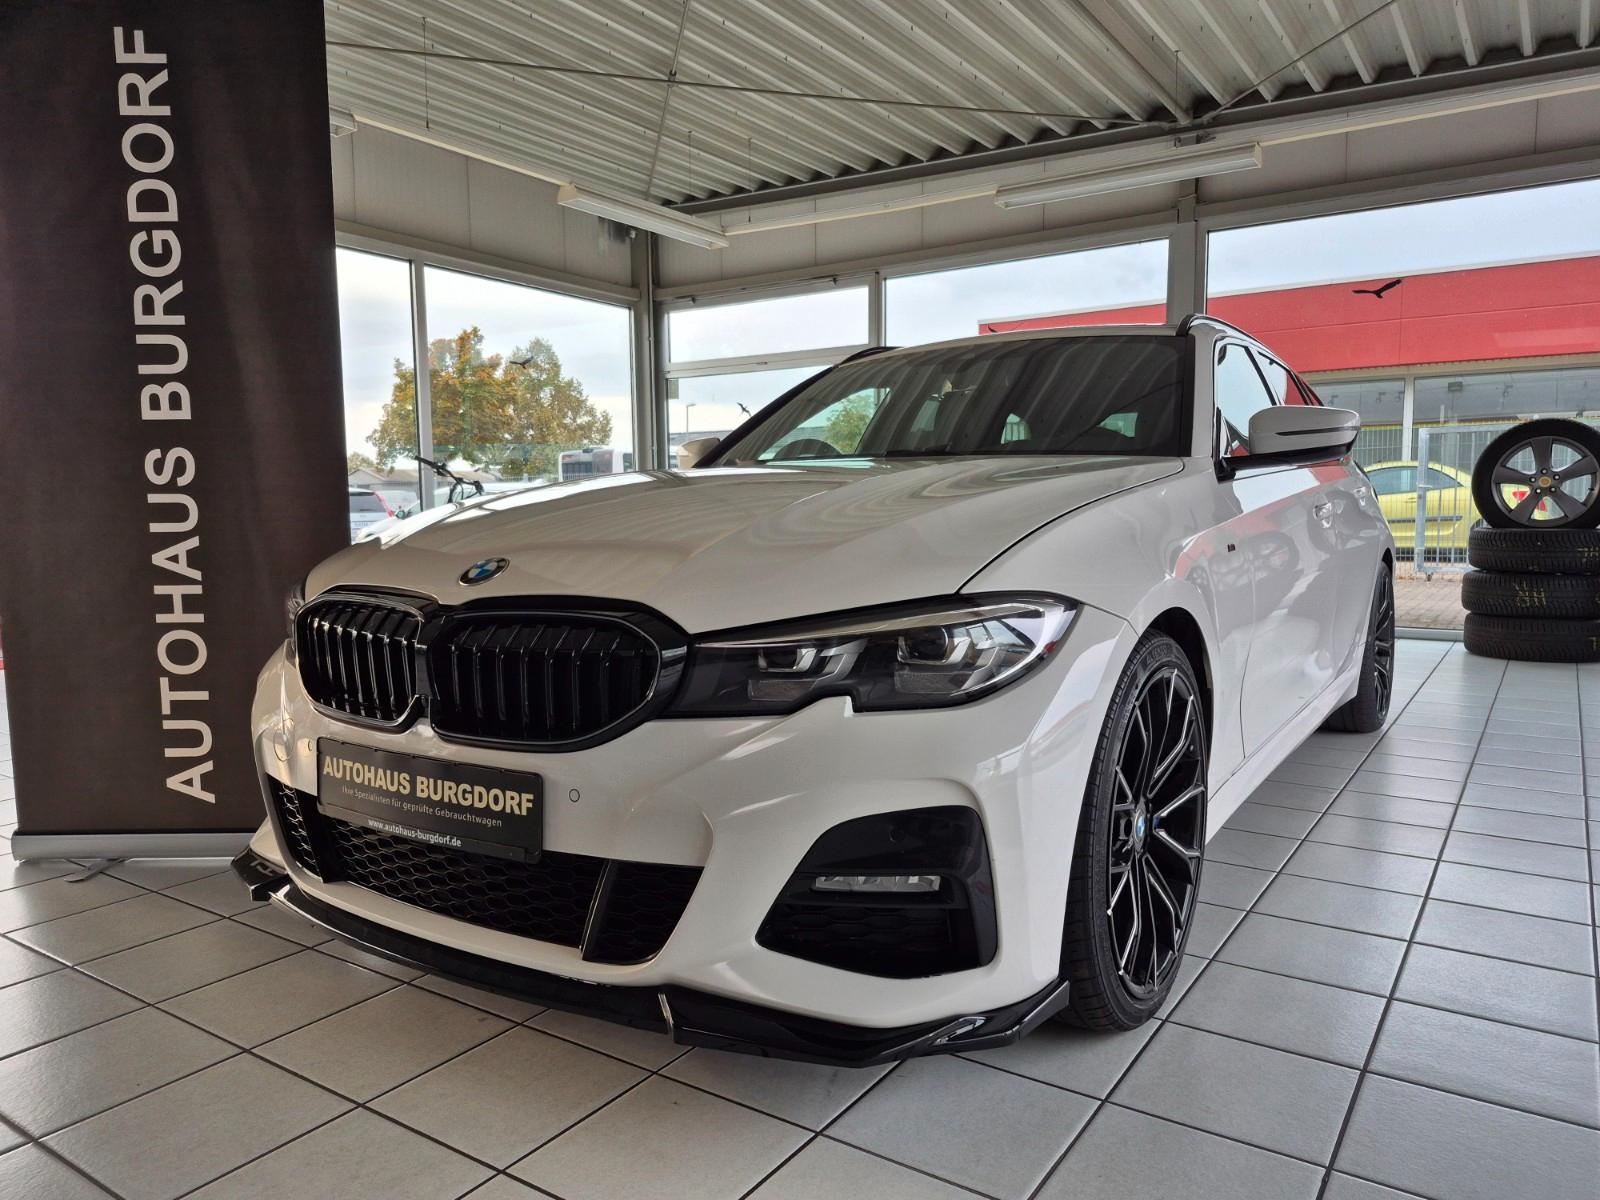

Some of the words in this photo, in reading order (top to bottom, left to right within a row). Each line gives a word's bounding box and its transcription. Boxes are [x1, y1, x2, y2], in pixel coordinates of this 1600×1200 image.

[113, 26, 192, 420] BURGDORF
[144, 446, 216, 804] AUTOHAUS
[323, 755, 411, 795] AUTOHAUS
[416, 775, 534, 816] BURGDORF
[391, 797, 402, 807] für
[402, 800, 434, 815] geprüfte
[435, 807, 502, 828] Gebrauchtwagen
[367, 819, 462, 847] www.autohaus-burgdorf.de
